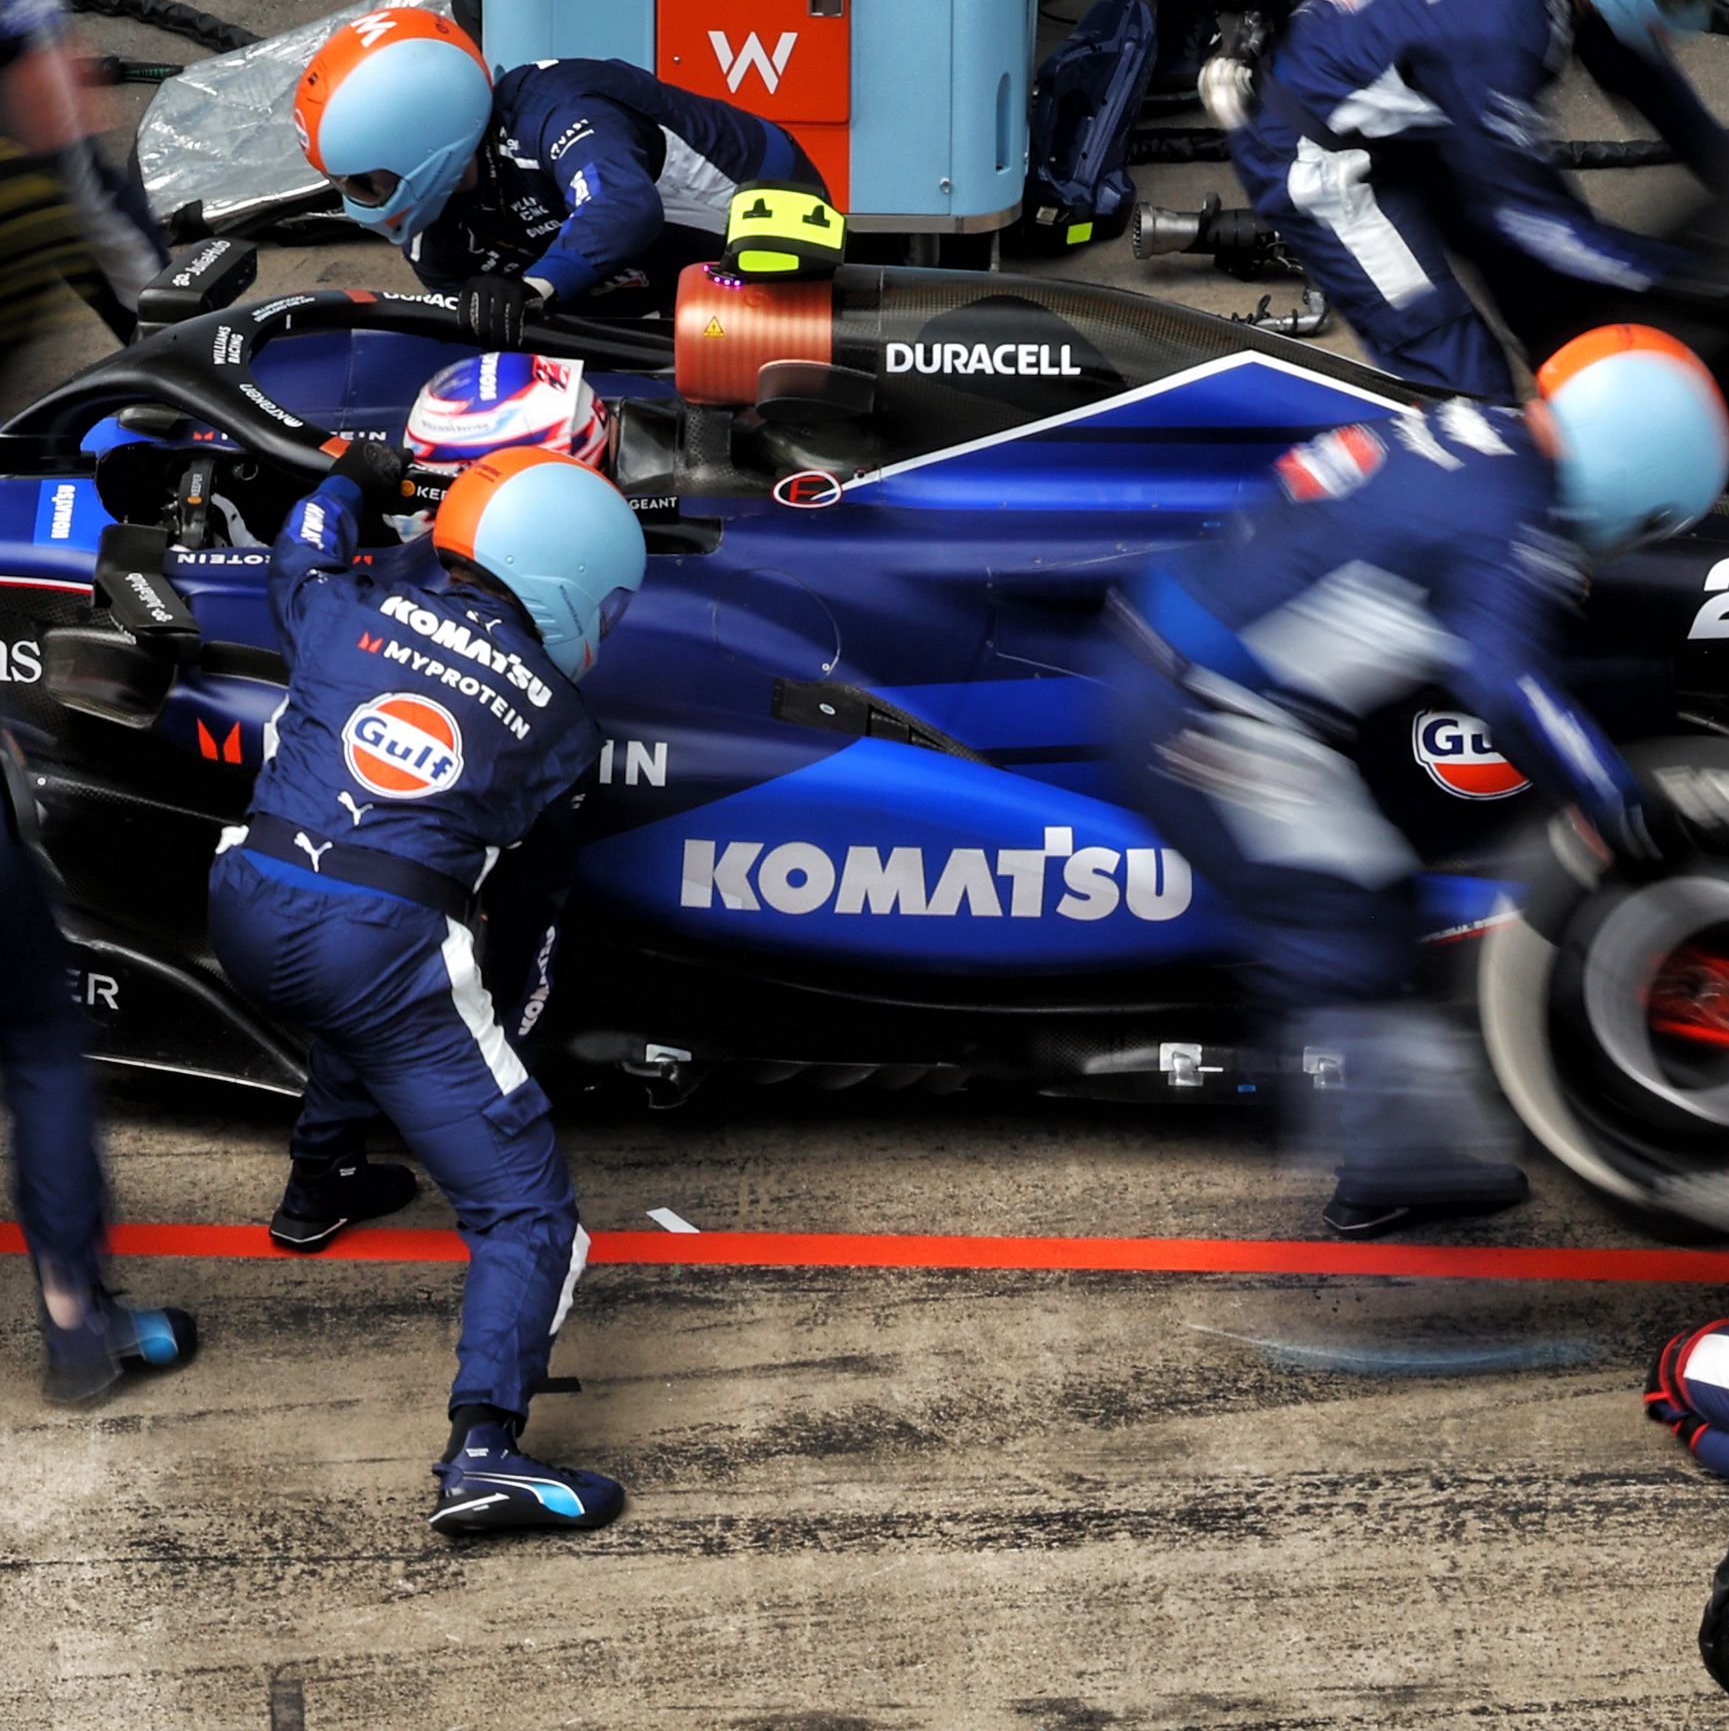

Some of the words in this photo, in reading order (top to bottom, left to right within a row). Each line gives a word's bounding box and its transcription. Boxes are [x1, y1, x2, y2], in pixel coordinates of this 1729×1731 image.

[707, 30, 799, 95] W
[381, 291, 459, 311] DURAC
[885, 343, 1082, 376] DURACELL
[51, 484, 76, 539] KOMATSU
[630, 496, 678, 511] GEANT
[379, 595, 553, 708] KOMATSU
[383, 640, 531, 740] MYPROTEIN
[354, 715, 455, 782] Gulf
[1422, 718, 1492, 757] Gu
[680, 827, 1194, 922] KOMATSU
